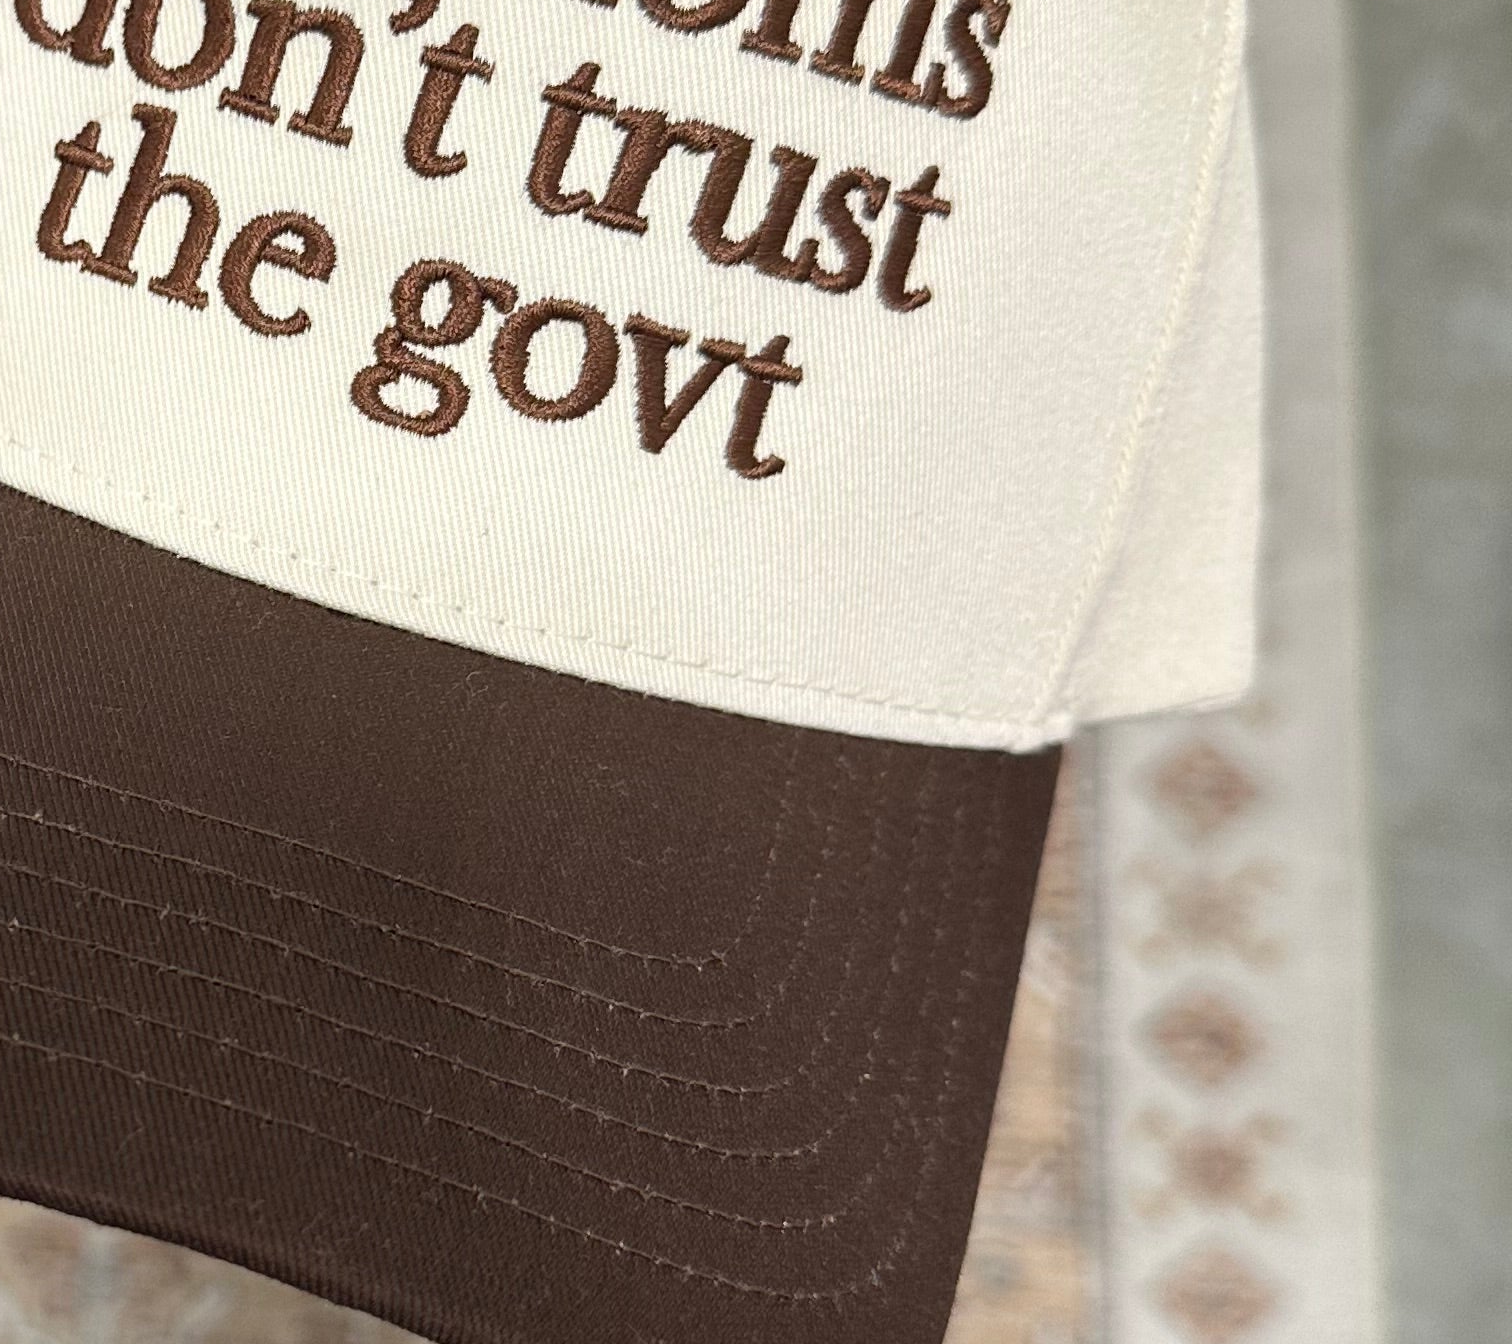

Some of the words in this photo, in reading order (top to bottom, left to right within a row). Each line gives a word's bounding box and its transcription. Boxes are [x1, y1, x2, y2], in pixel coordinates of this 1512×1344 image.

[35, 104, 336, 337] the
[350, 257, 802, 479] govt
[526, 62, 952, 312] trust
